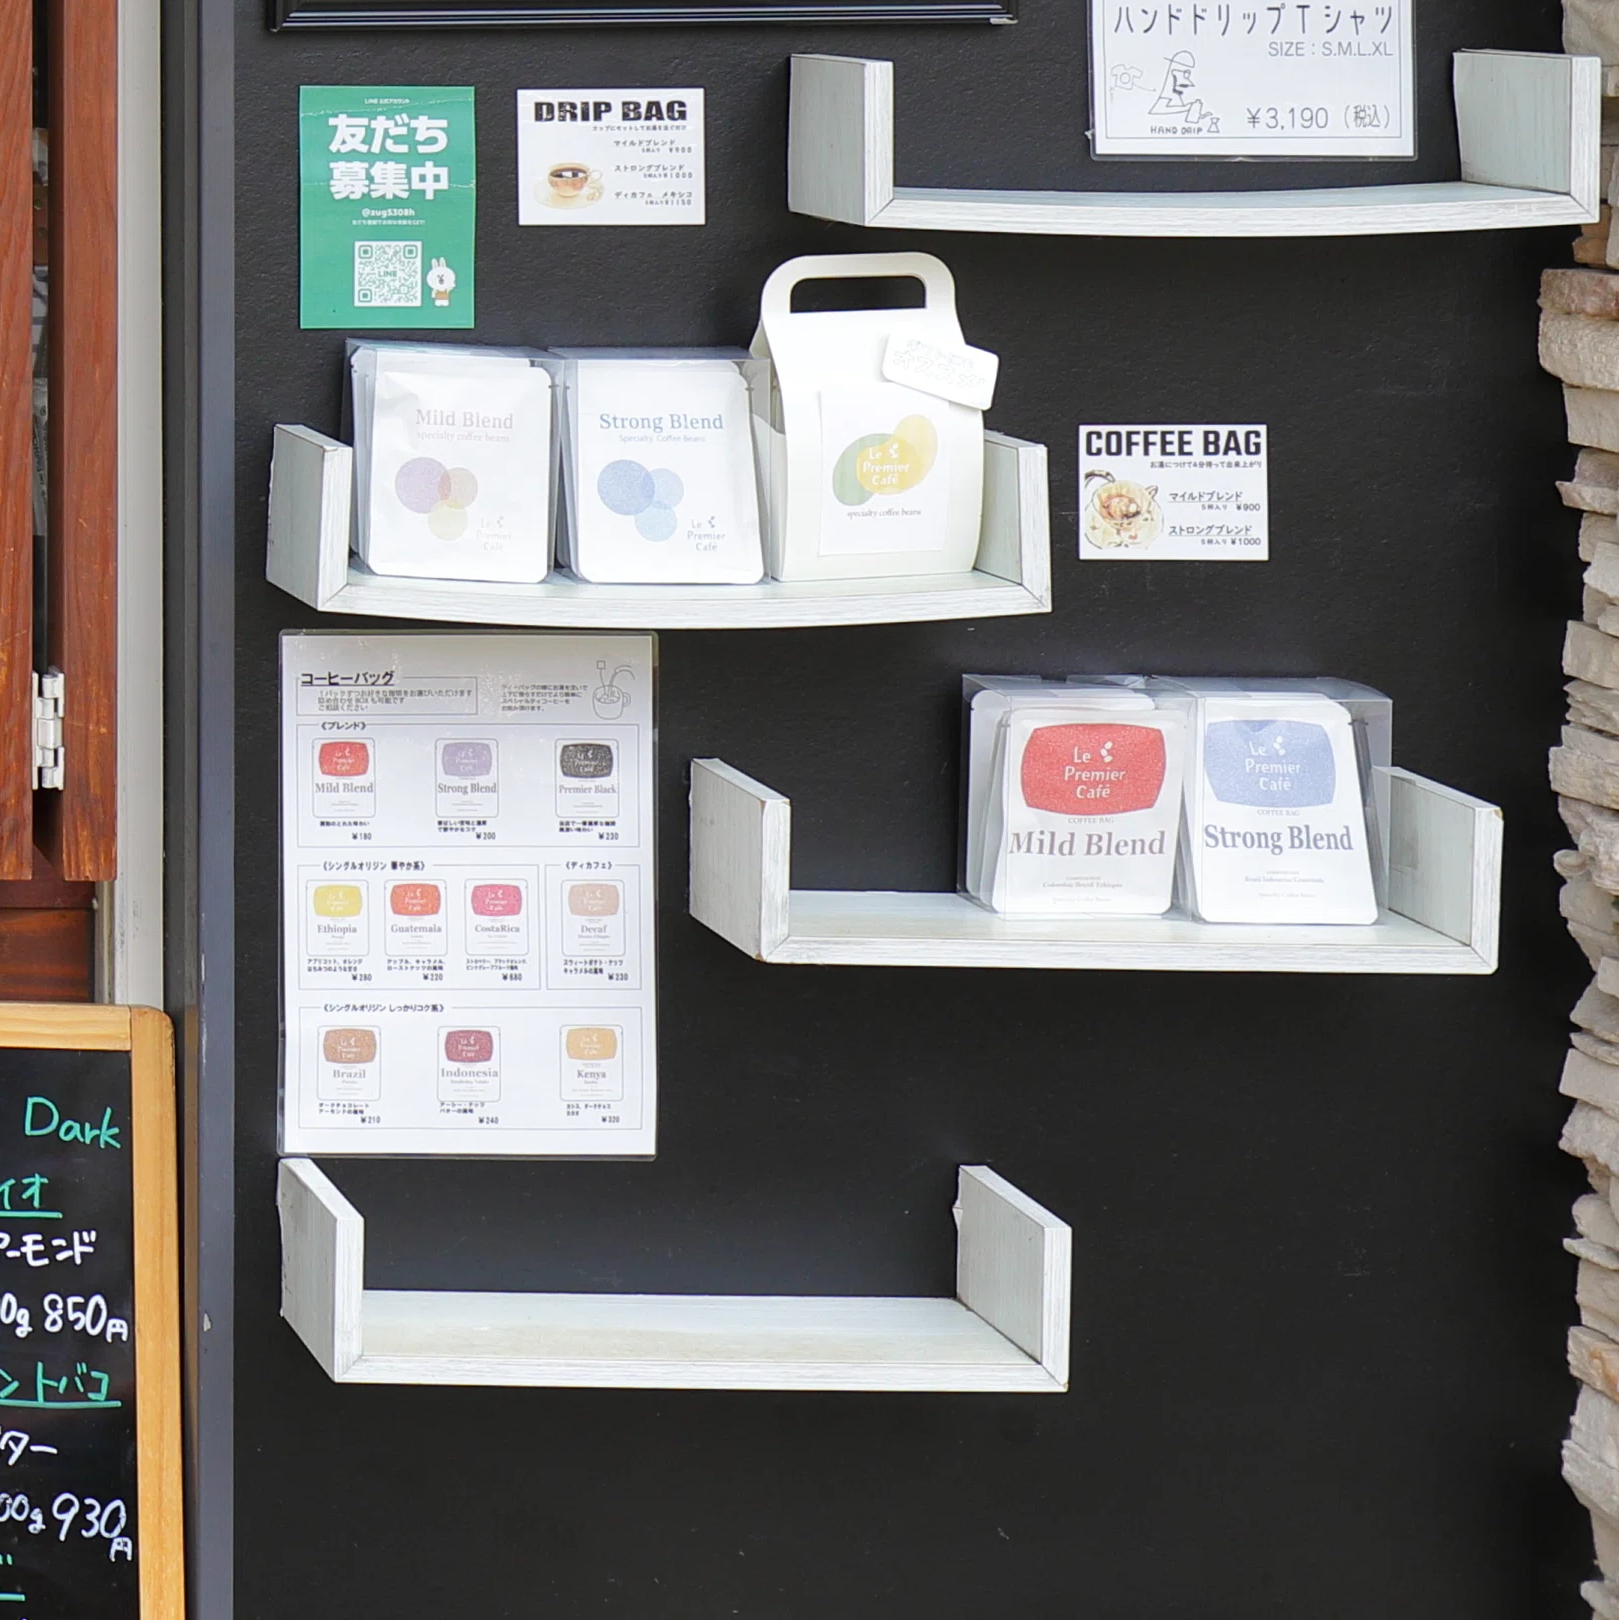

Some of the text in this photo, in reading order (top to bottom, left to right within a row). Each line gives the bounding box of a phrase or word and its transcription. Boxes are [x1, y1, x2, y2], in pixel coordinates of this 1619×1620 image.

[534, 100, 687, 122] DRIP BAG
[328, 113, 448, 154] 友だち
[329, 160, 449, 200] 募集中
[415, 408, 514, 429] Mild Blend
[599, 413, 724, 434] Strong Blend
[1085, 430, 1262, 457] COFFEE BAG
[862, 461, 910, 475] Premier
[1169, 491, 1243, 501] マイルドブレンド
[1169, 525, 1253, 535] ストロングブレンド
[301, 671, 395, 685] コーヒーバッグ
[1074, 746, 1091, 763] Le
[1249, 741, 1267, 756] Le
[1064, 766, 1126, 781] Premier
[1245, 759, 1301, 775] Premier
[315, 783, 373, 793] Mild Blend
[437, 782, 497, 795] Strong Blend
[1076, 783, 1111, 799] Café
[1259, 776, 1291, 791] Café
[1009, 829, 1166, 856] Mild Blend
[1204, 825, 1354, 855] Strong Blend
[317, 924, 357, 935] Ethiopia
[391, 924, 442, 933] Guatemala
[581, 924, 608, 933] Decaf
[333, 1069, 366, 1079] Brazil
[441, 1067, 498, 1078] Indonesia
[577, 1070, 606, 1080] Kenya
[24, 1096, 122, 1149] Dark
[37, 1362, 111, 1403] トバコ
